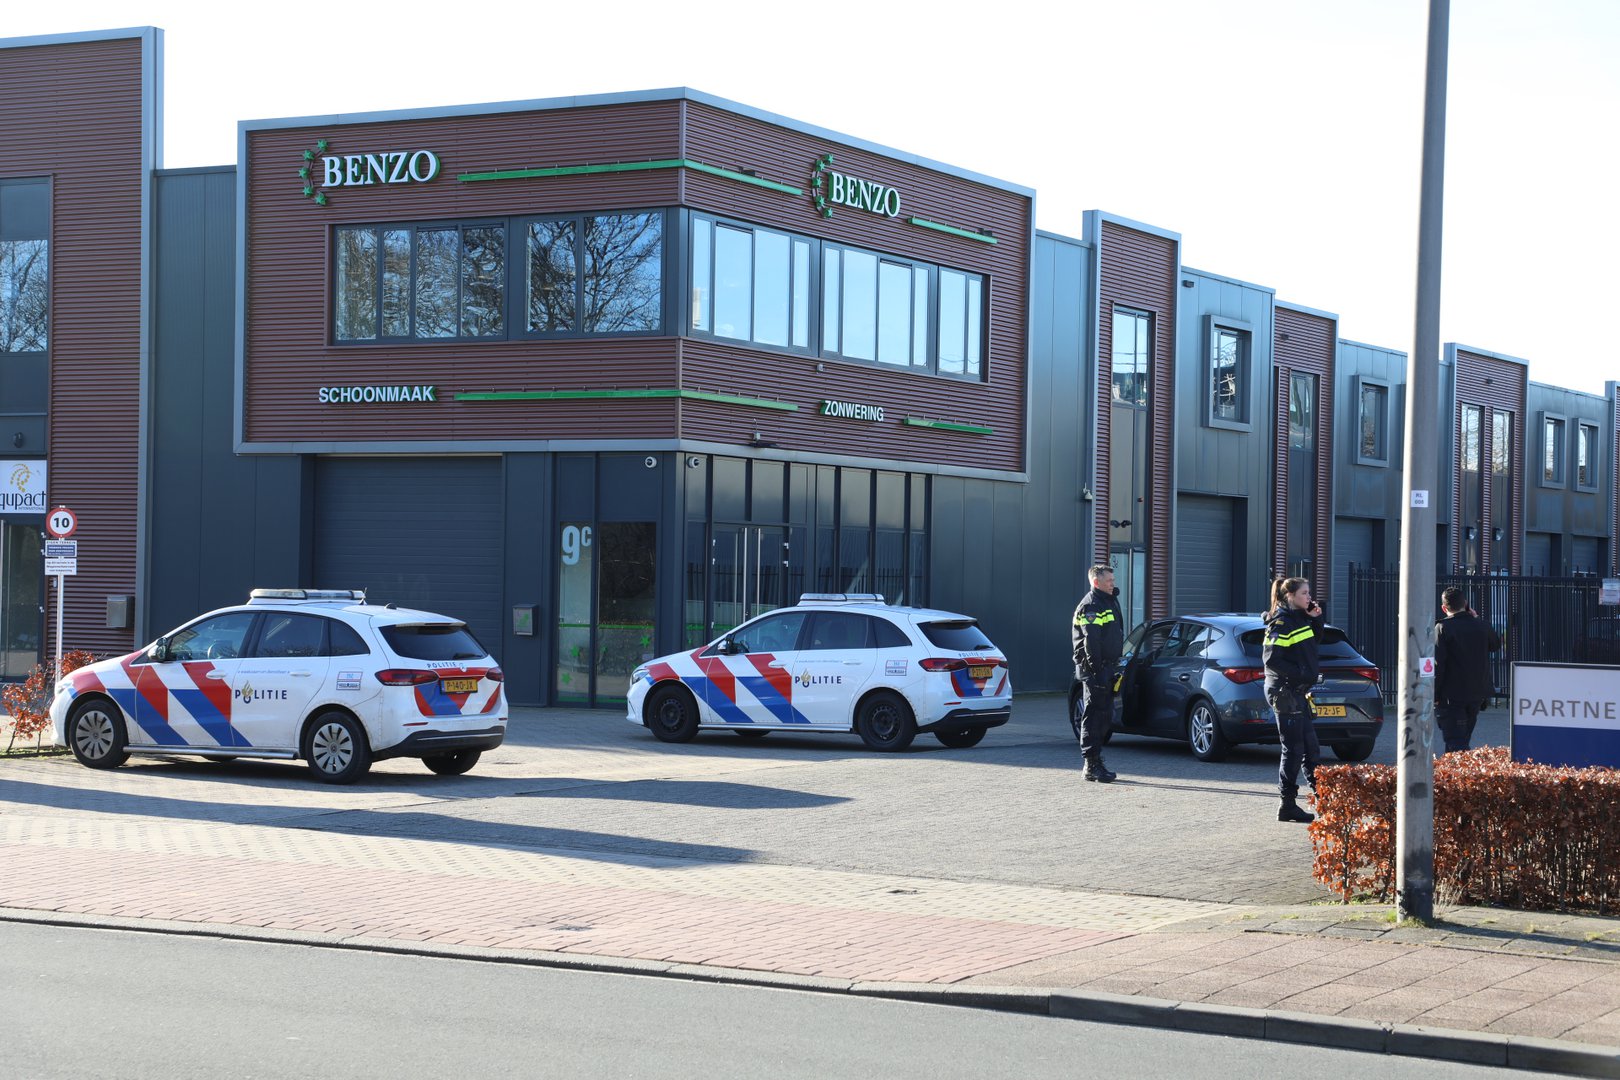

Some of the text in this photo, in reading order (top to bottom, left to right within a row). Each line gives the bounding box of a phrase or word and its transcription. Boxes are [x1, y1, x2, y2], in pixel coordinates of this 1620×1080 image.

[321, 150, 440, 187] BENZO
[829, 171, 901, 218] BENZO
[318, 385, 436, 404] SCHOONMAAK
[822, 400, 884, 422] ZONWERING
[53, 517, 70, 528] 10
[795, 676, 842, 688] POLITIE
[235, 689, 288, 704] POLITIE
[1519, 698, 1617, 719] PARTNE
